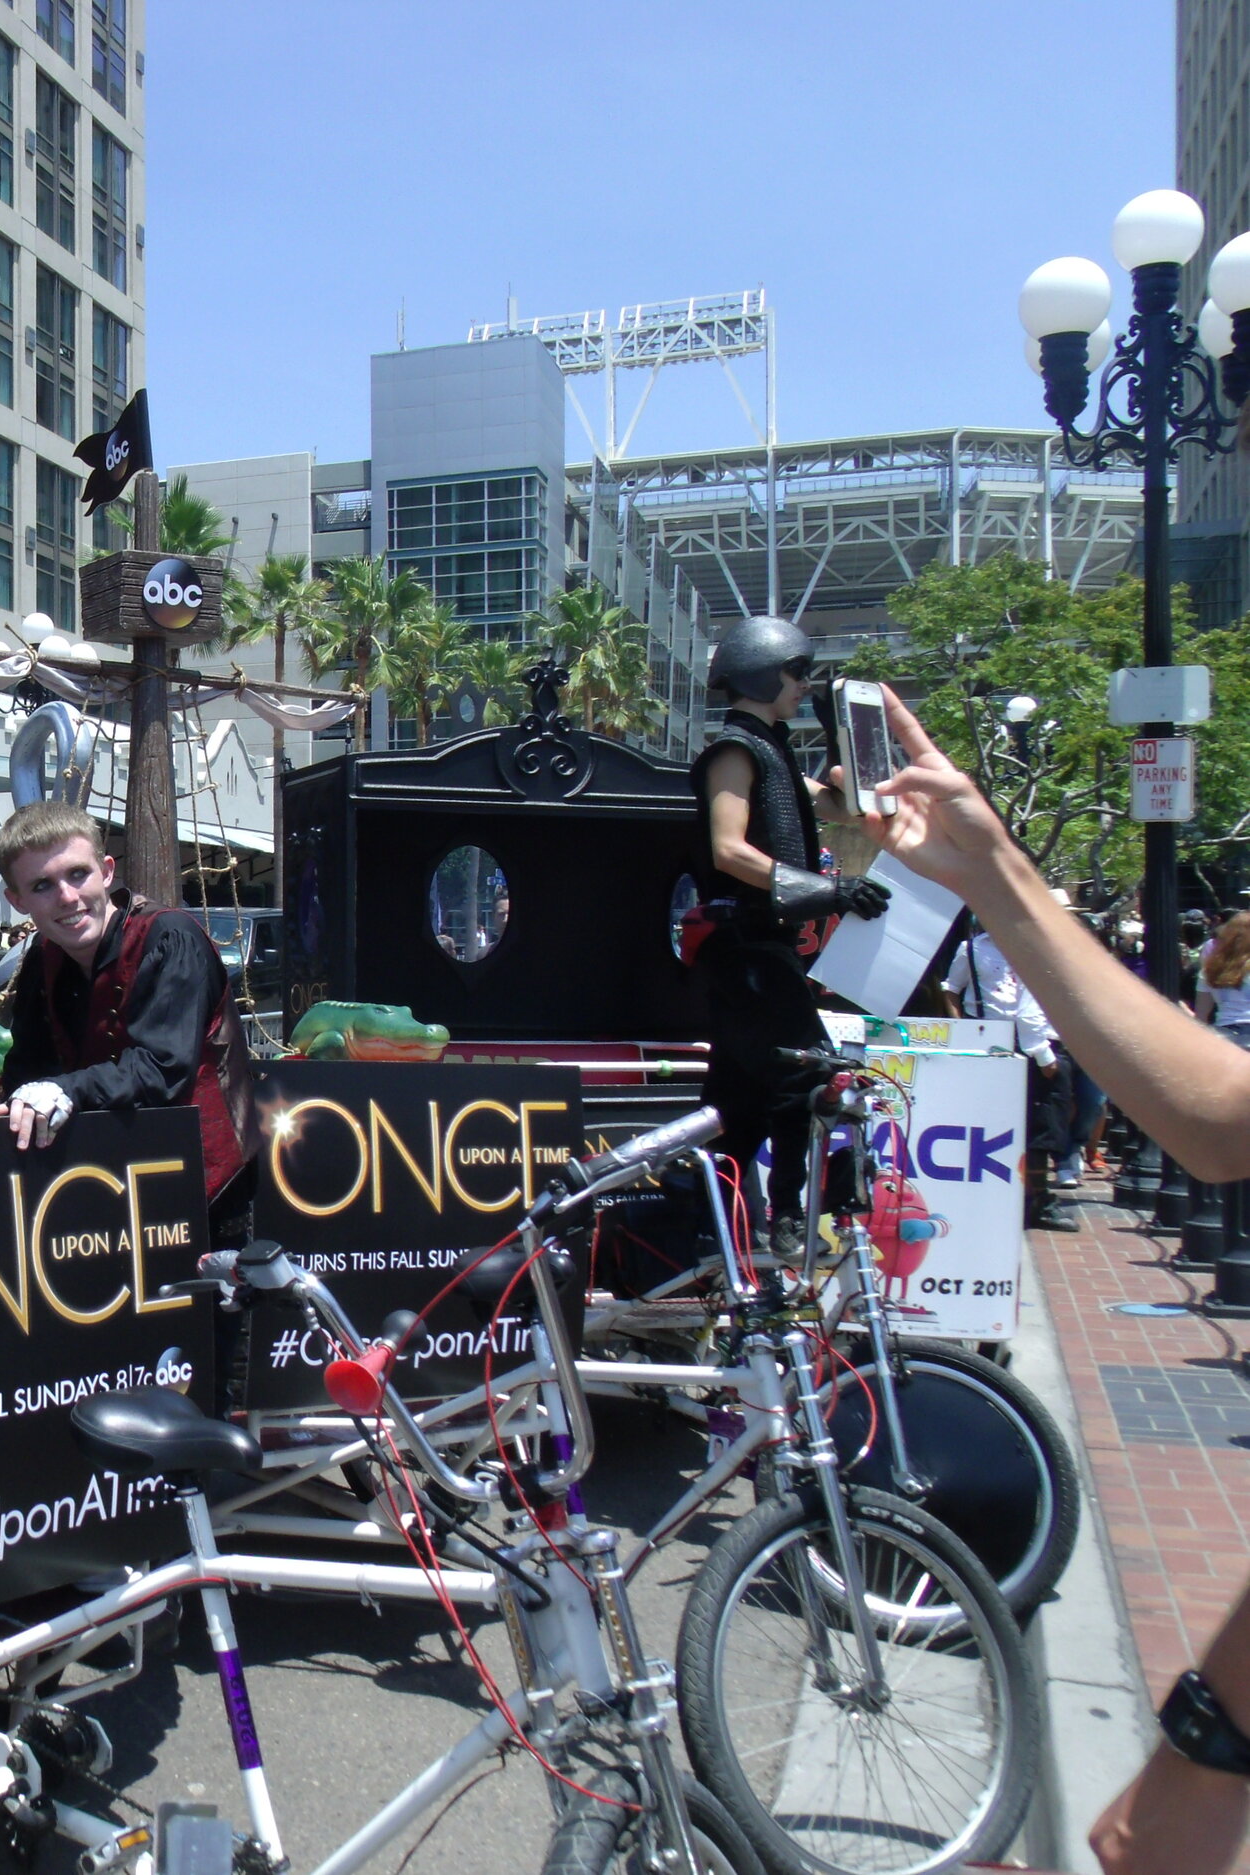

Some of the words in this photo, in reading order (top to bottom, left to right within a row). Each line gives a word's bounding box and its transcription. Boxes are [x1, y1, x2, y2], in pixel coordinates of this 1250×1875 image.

[105, 439, 130, 471] abc
[144, 574, 203, 608] abc
[1133, 743, 1155, 761] NO
[1136, 766, 1188, 782] PARKING
[1152, 784, 1172, 796] ANY
[1151, 798, 1173, 811] TIME
[271, 1098, 568, 1217] ONCE
[459, 1147, 506, 1165] UPON
[511, 1147, 524, 1164] A
[533, 1147, 571, 1164] TIME
[52, 1231, 110, 1260] UPON
[117, 1228, 132, 1252] A
[144, 1222, 191, 1248] TIME
[297, 1253, 347, 1273] TURNS
[350, 1252, 386, 1271] THIS
[390, 1250, 424, 1269] FALL
[921, 1277, 964, 1296] OCT
[972, 1280, 1013, 1297] 2013
[14, 1372, 110, 1415] SUNDAYS
[155, 1360, 193, 1386] abc
